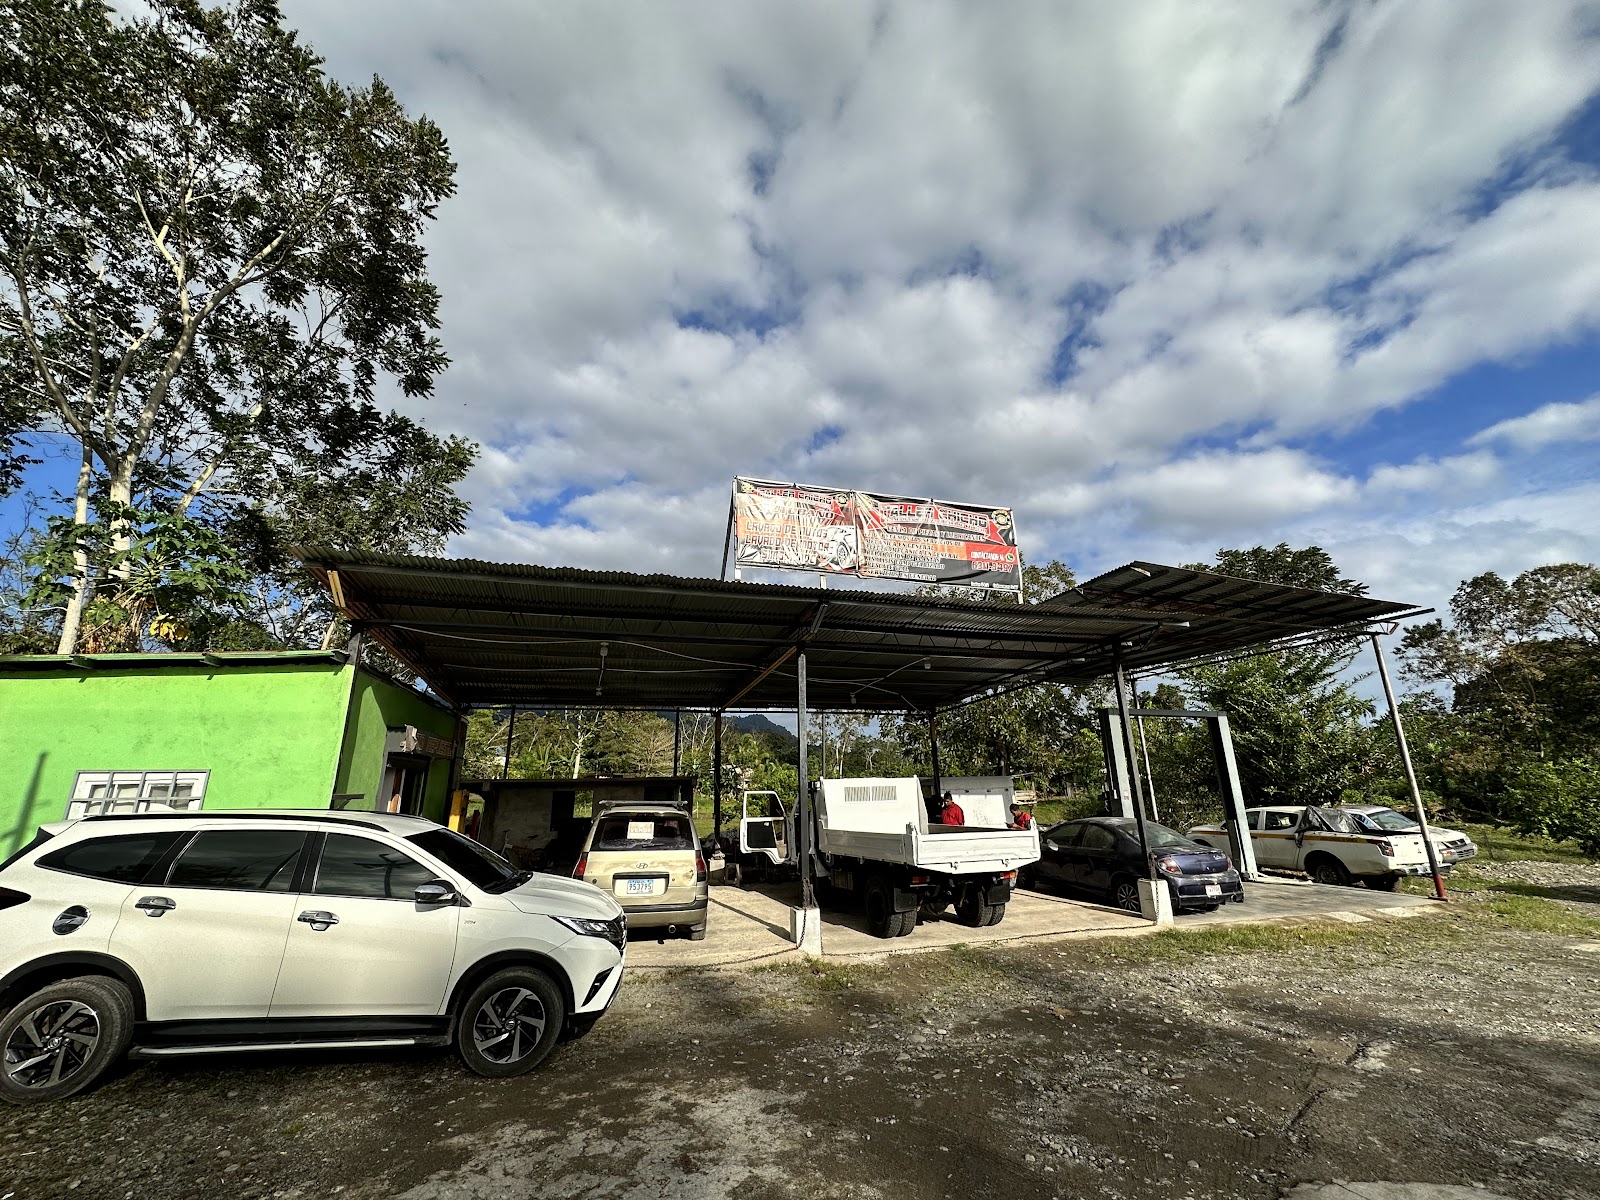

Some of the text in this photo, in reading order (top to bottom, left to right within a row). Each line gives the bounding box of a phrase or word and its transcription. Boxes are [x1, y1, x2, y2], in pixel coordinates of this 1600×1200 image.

[883, 505, 934, 518] TALLER
[938, 508, 988, 528] CHICHO
[745, 534, 781, 547] LAVADO
